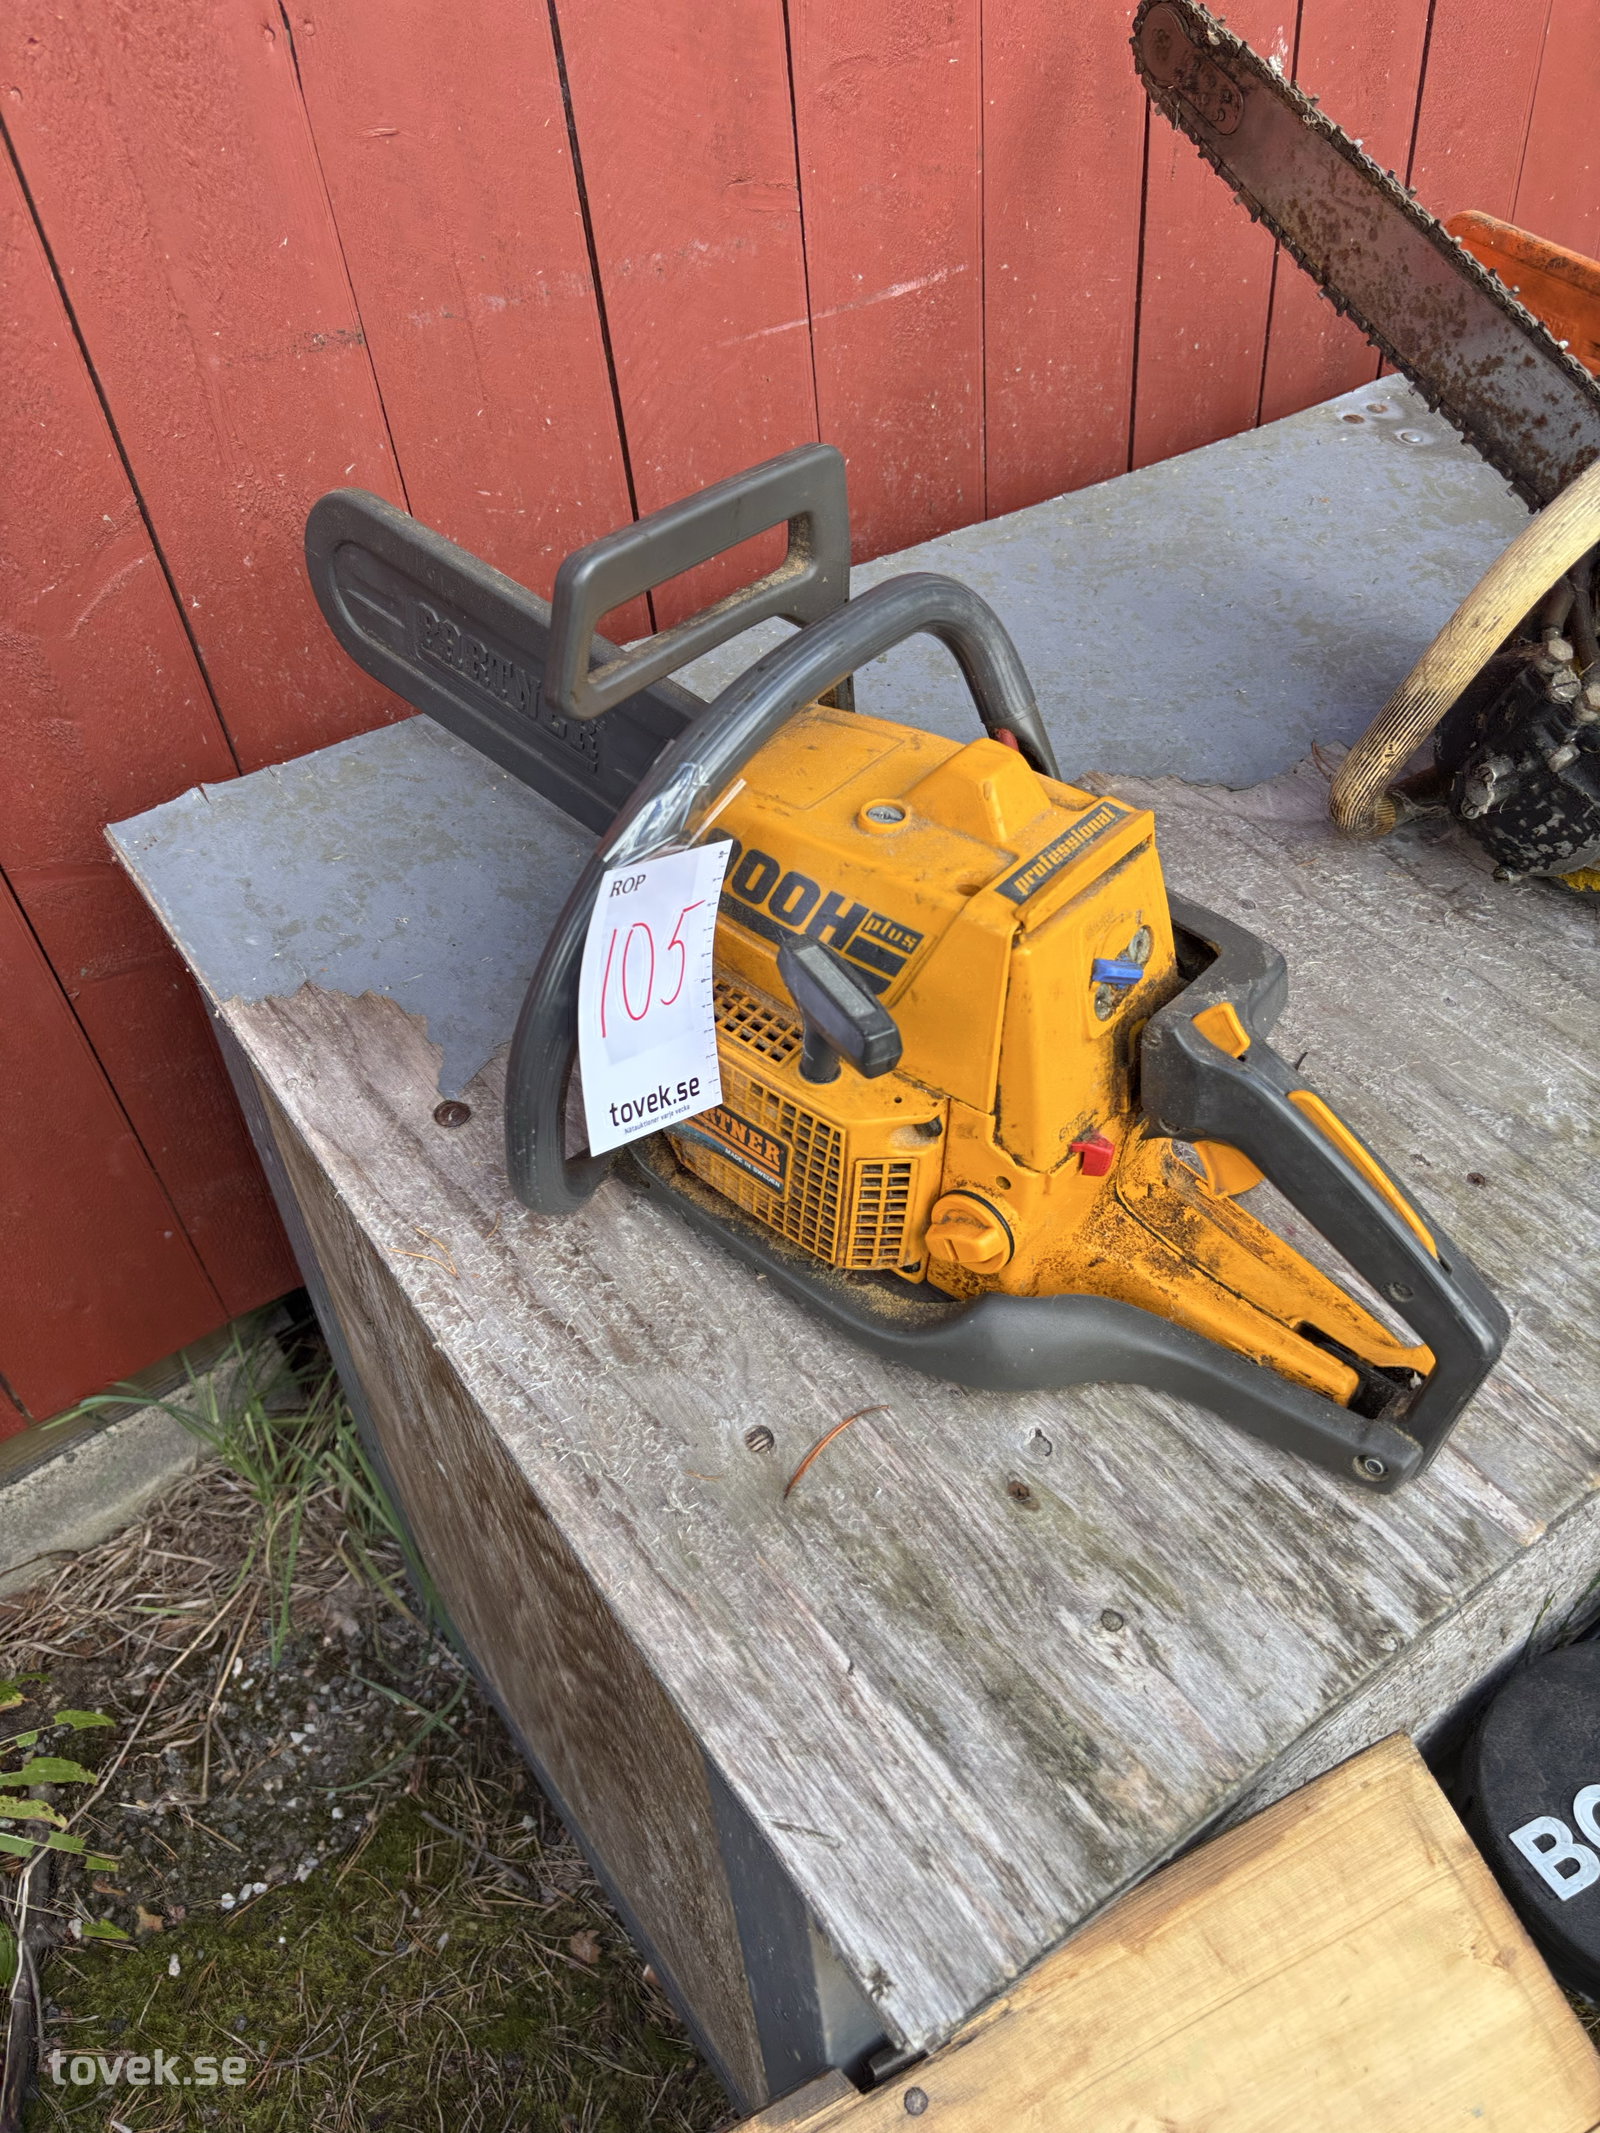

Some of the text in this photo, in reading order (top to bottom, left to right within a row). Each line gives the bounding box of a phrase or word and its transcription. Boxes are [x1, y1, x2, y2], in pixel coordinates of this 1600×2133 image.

[1013, 805, 1116, 896] professional
[609, 873, 647, 898] ROP
[863, 915, 919, 950] plus
[601, 899, 706, 1038] 105
[609, 1077, 701, 1127] tovek.se
[724, 1147, 780, 1188] MADE IN SWEDEN
